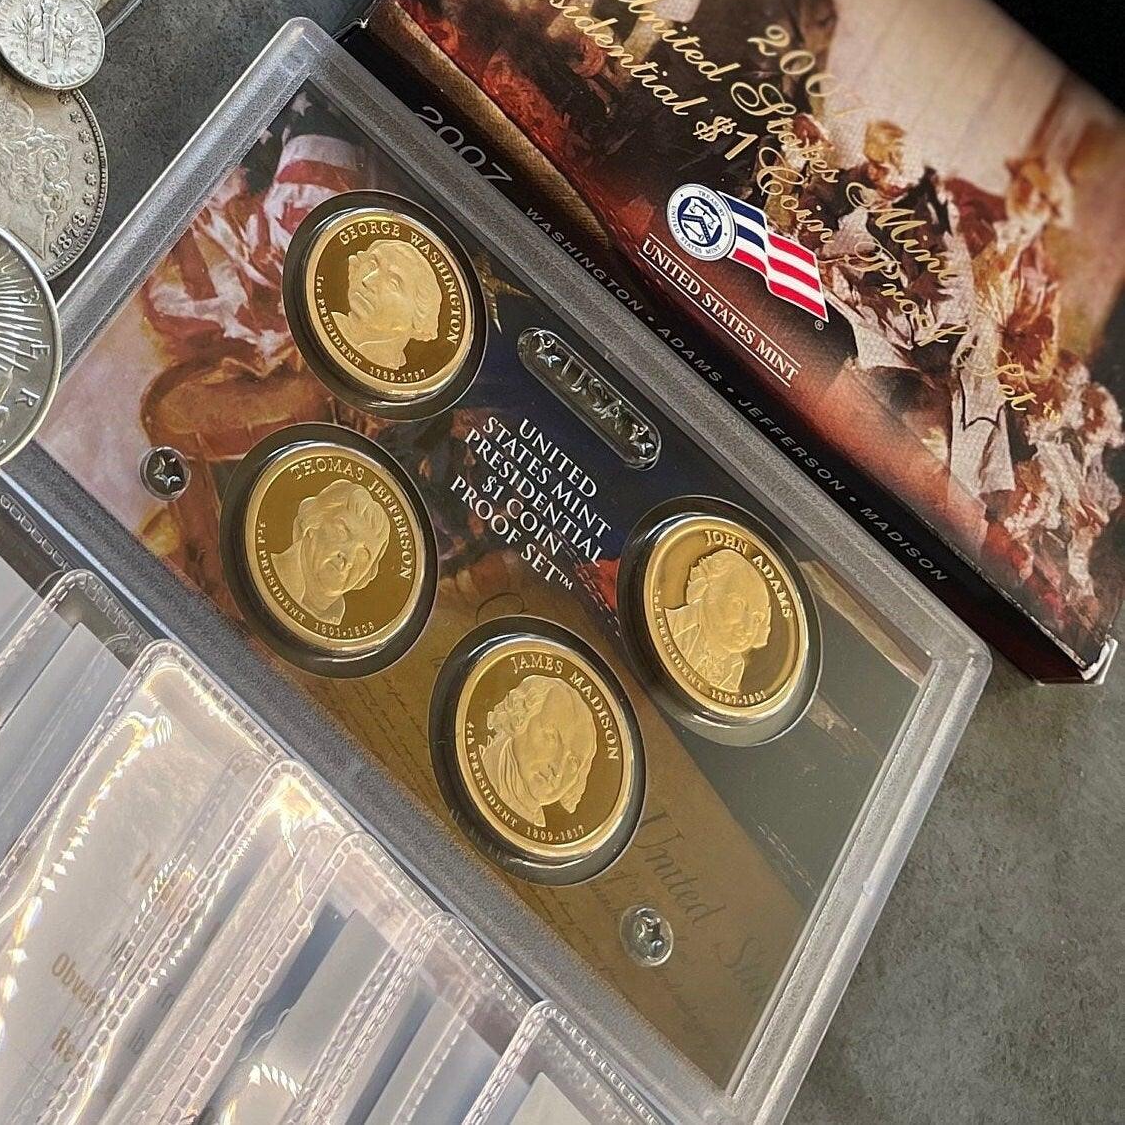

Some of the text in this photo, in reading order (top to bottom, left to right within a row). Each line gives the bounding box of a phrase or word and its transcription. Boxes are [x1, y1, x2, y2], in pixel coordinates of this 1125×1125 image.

[693, 114, 758, 163] $1
[755, 146, 833, 246] Coin
[731, 72, 840, 185] States
[697, 189, 726, 217] TREASURY
[317, 297, 364, 367] PRESIDENT
[338, 220, 465, 346] GEORGE WASHINGTON
[641, 239, 802, 383] UNITED STATES MINT
[525, 206, 950, 582] WASHINGTON ADAMS JEFFERSON MADISON
[450, 475, 522, 546] PROOF
[464, 427, 604, 568] PRESIDENTIAL
[483, 416, 612, 540] STATES MINT
[519, 419, 598, 498] UNITED
[289, 457, 412, 582] THOMAS JEFFERSON
[481, 476, 563, 556] $1 COIN
[258, 549, 308, 626] PRESIDENT
[703, 529, 795, 620] JOHN ADAMS
[510, 654, 621, 763] JAMES MADISON
[466, 749, 519, 829] PRESIDENT
